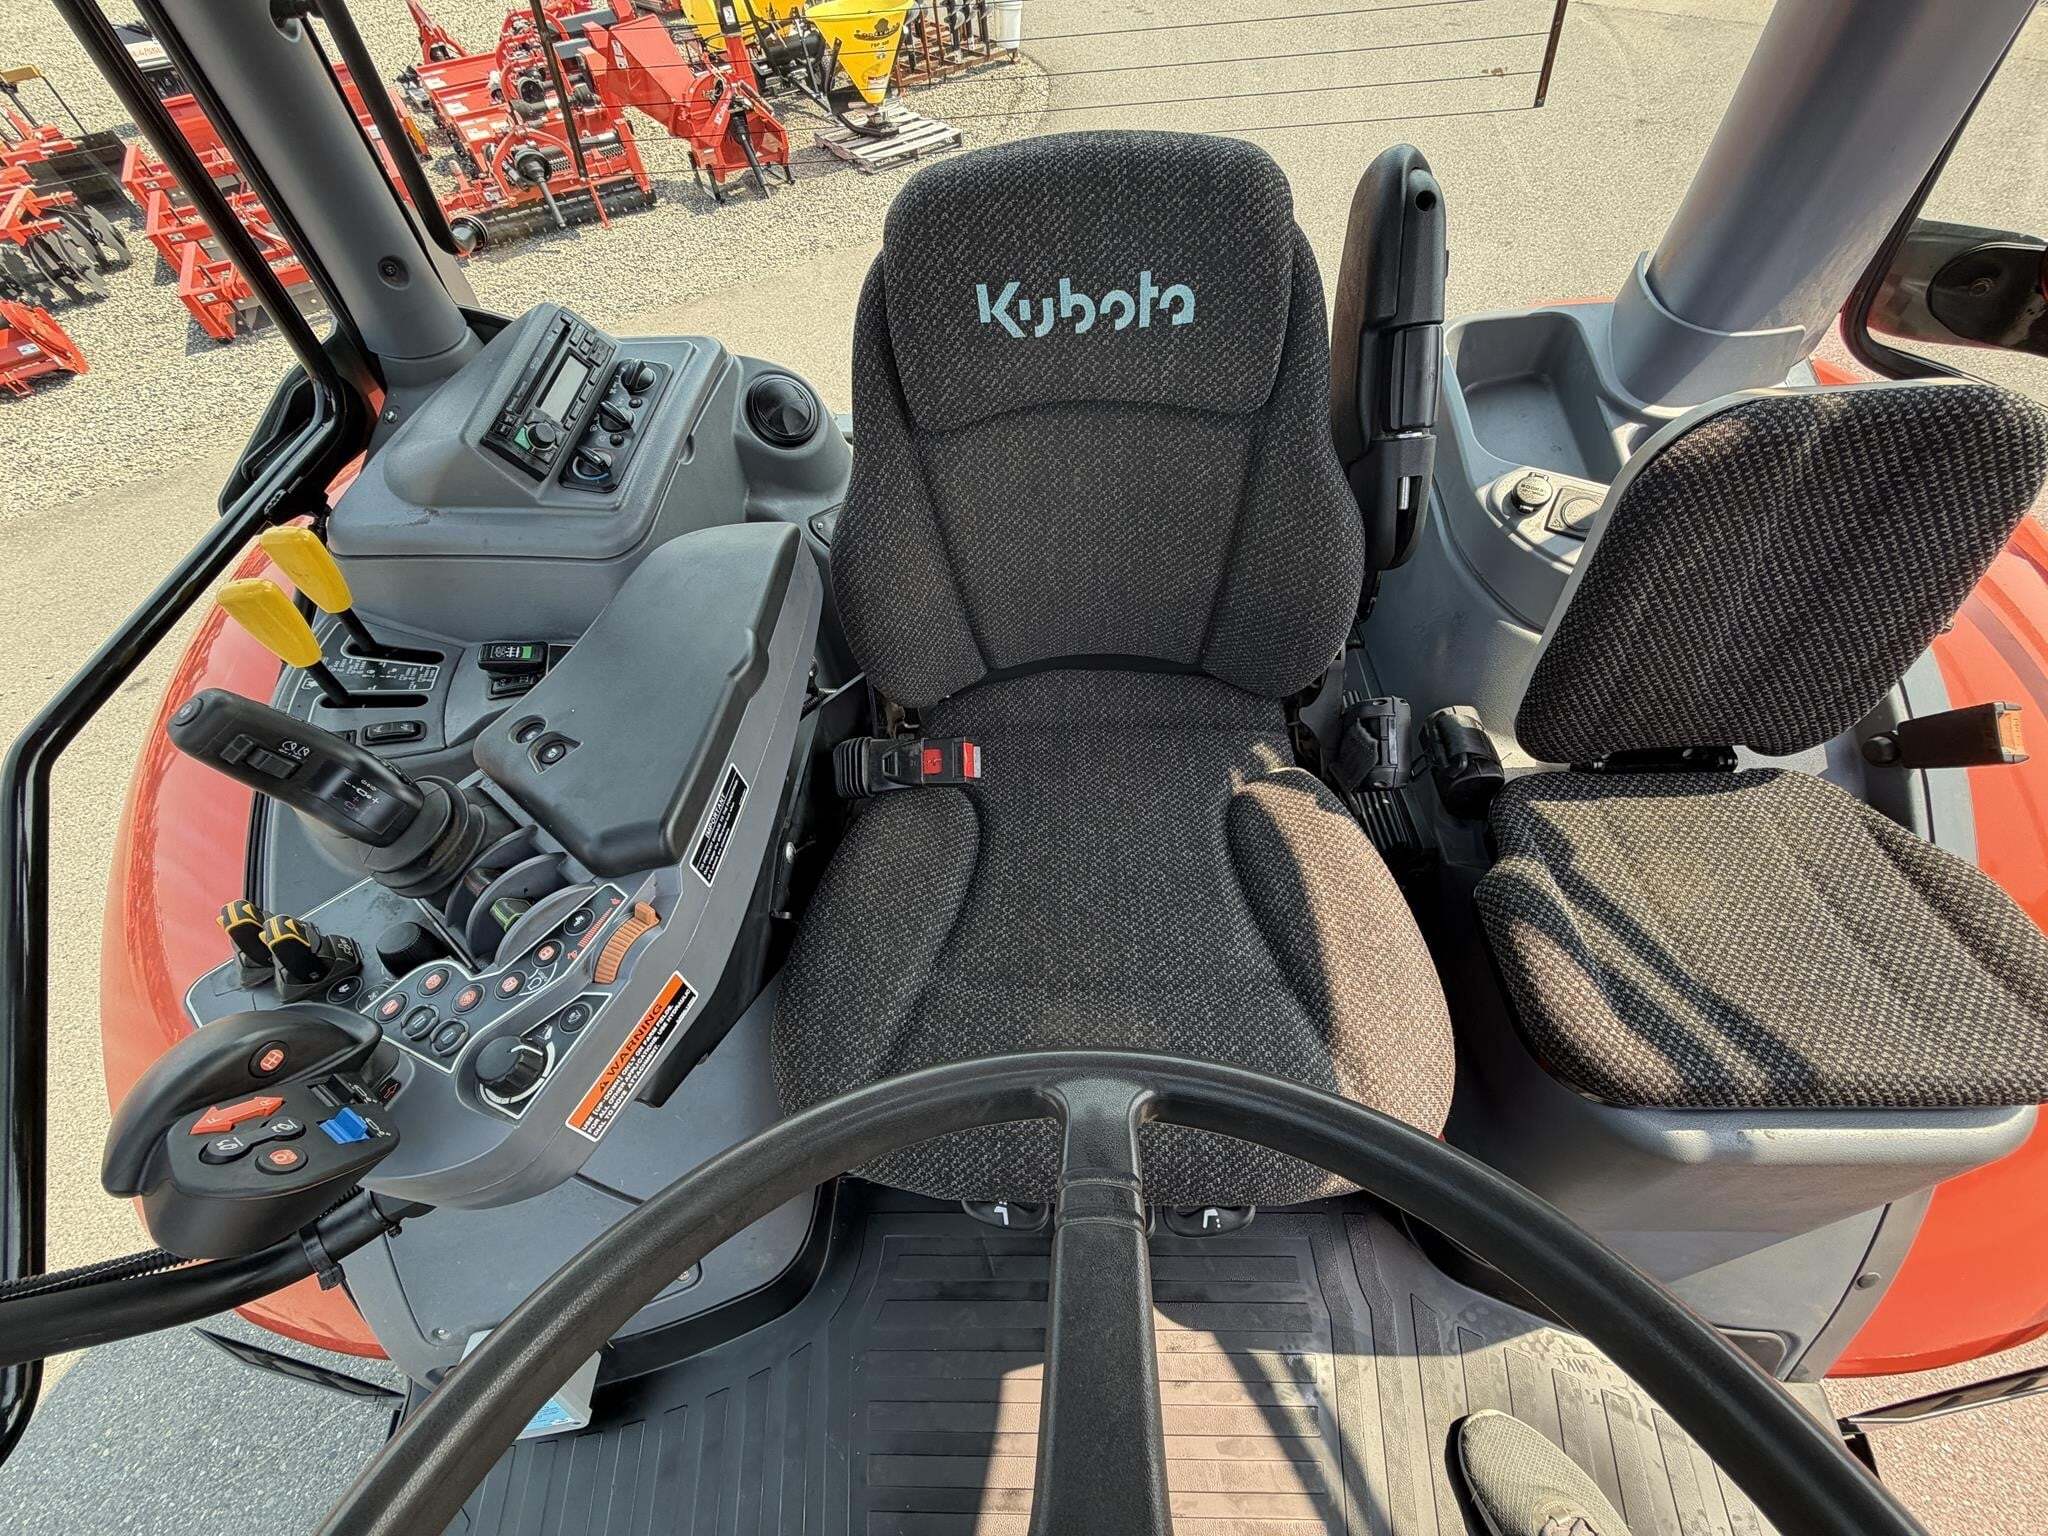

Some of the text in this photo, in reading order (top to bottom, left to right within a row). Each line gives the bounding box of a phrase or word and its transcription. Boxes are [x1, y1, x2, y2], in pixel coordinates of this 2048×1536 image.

[975, 270, 1195, 338] Kubota
[705, 793, 726, 839] IMPORTANT
[581, 1116, 594, 1130] USE
[622, 1056, 636, 1076] ONLY
[635, 1046, 644, 1056] ON
[643, 1027, 657, 1046] FARM
[656, 1005, 673, 1027] FIELDS.
[587, 1119, 600, 1133] FOR
[599, 1106, 610, 1118] ALL
[608, 1082, 626, 1104] OTHER
[657, 1022, 668, 1035] USE
[666, 989, 691, 1022] HYDRAULIC
[607, 1003, 662, 1075] WARNING
[593, 1045, 660, 1136] DIAL TO MOVE ATTACHMENT.
